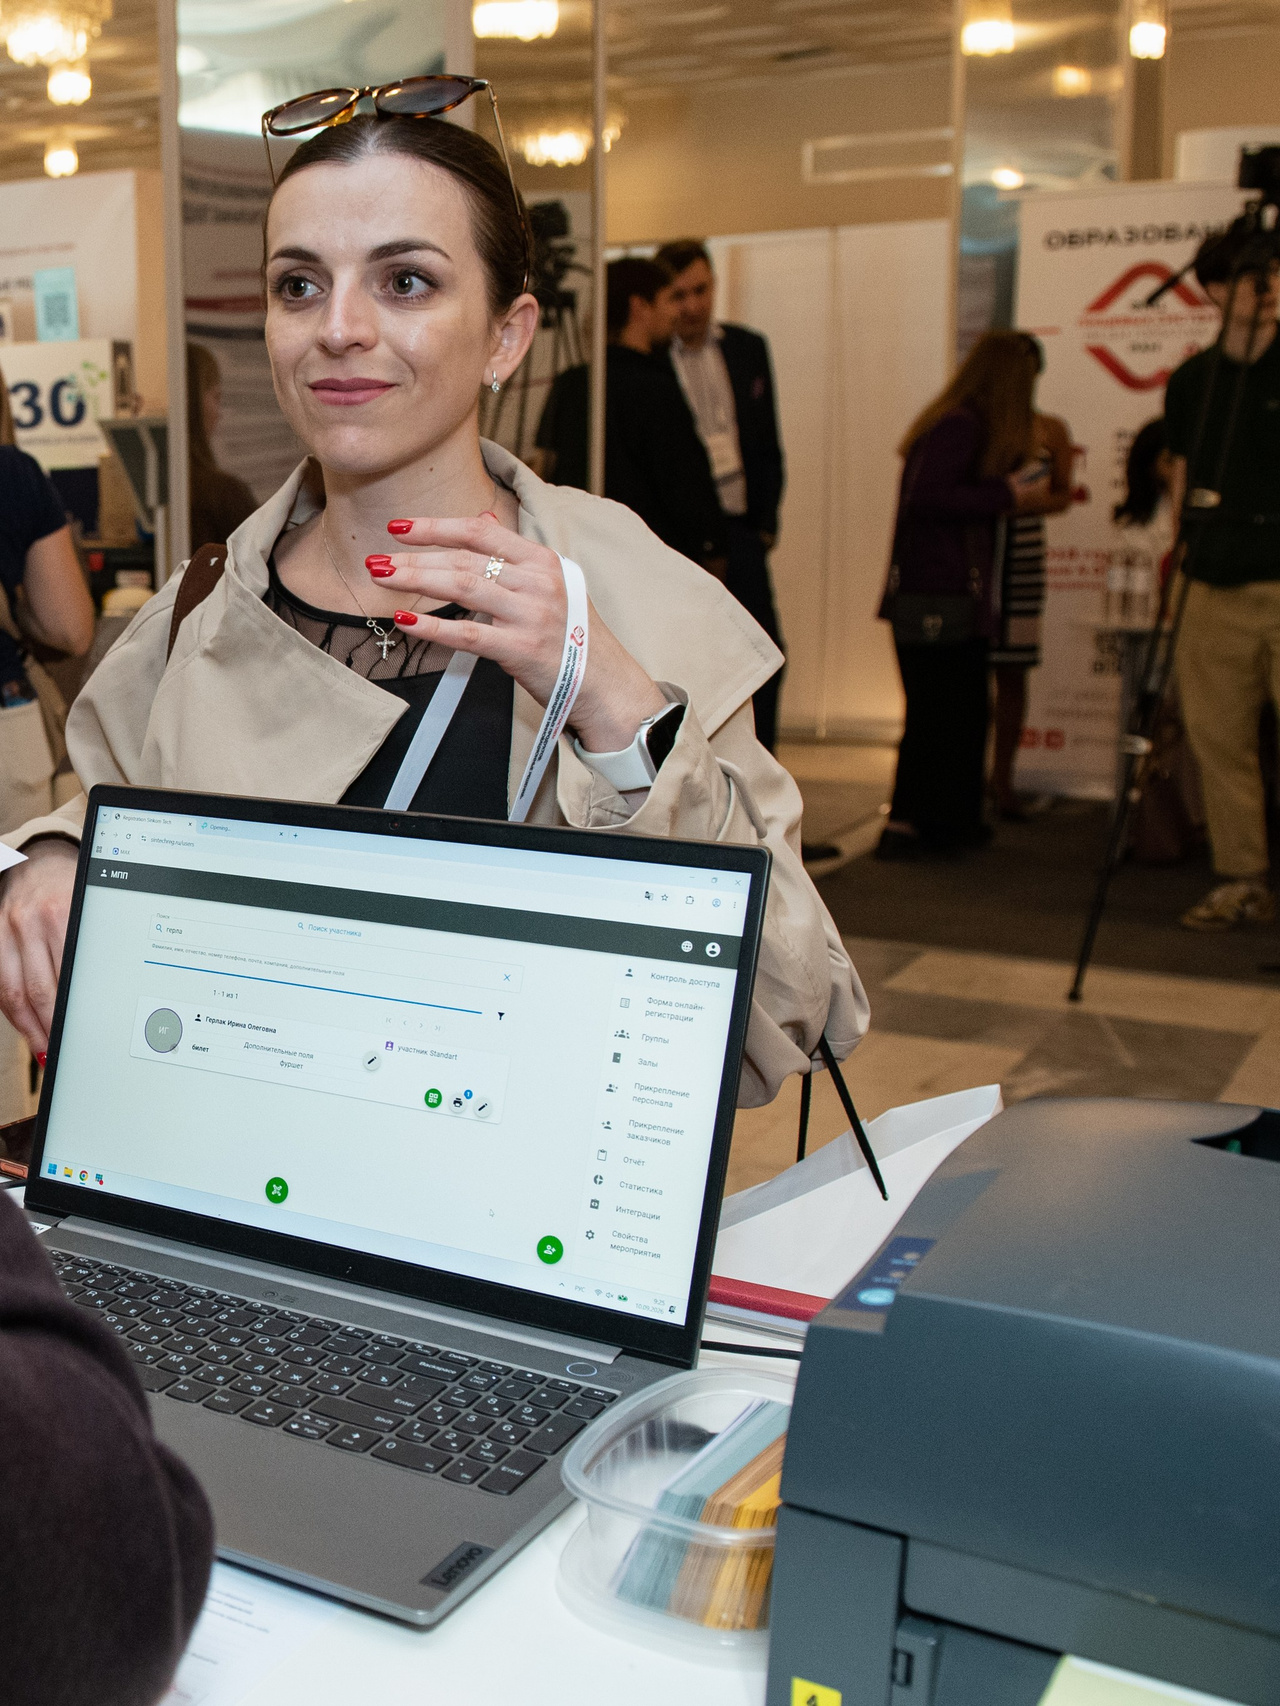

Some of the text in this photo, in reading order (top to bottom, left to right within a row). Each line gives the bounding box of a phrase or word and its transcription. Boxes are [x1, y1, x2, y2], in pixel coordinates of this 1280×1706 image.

[10, 379, 87, 430] 30
[111, 870, 129, 880] МПП
[308, 924, 362, 938] Поиск участника
[650, 972, 721, 989] Контроль доступа
[646, 996, 706, 1011] Форма онлайн-
[644, 1010, 694, 1023] регистрации
[158, 1026, 170, 1035] ИГ
[227, 1019, 247, 1029] Ирина
[247, 1023, 277, 1034] Олеговна
[641, 1033, 670, 1044] Группы
[191, 1044, 209, 1053] билет
[243, 1041, 314, 1060] Дополнительные поля
[397, 1045, 458, 1060] участник Standart
[279, 1059, 304, 1070] фуршет
[638, 1057, 659, 1068] Залы
[634, 1082, 691, 1099] Прикрепление
[632, 1095, 673, 1109] персонала
[628, 1119, 685, 1136] Прикрепление
[626, 1132, 671, 1147] заказчиков
[623, 1155, 646, 1167] Отчёт
[619, 1180, 663, 1196] Статистика
[615, 1205, 661, 1222] Интеграции
[612, 1230, 649, 1245] Свойства
[610, 1243, 662, 1261] мероприятия
[419, 1361, 457, 1375] Backspace
[393, 1398, 416, 1408] Enter
[487, 1397, 498, 1405] 8
[522, 1406, 533, 1414] 9
[374, 1416, 394, 1425] Shift
[502, 1424, 513, 1432] 6
[445, 1432, 457, 1440] 2
[385, 1441, 397, 1449] 0
[481, 1442, 493, 1450] 3
[500, 1465, 525, 1477] Enter
[431, 1547, 483, 1586] Lenovo
